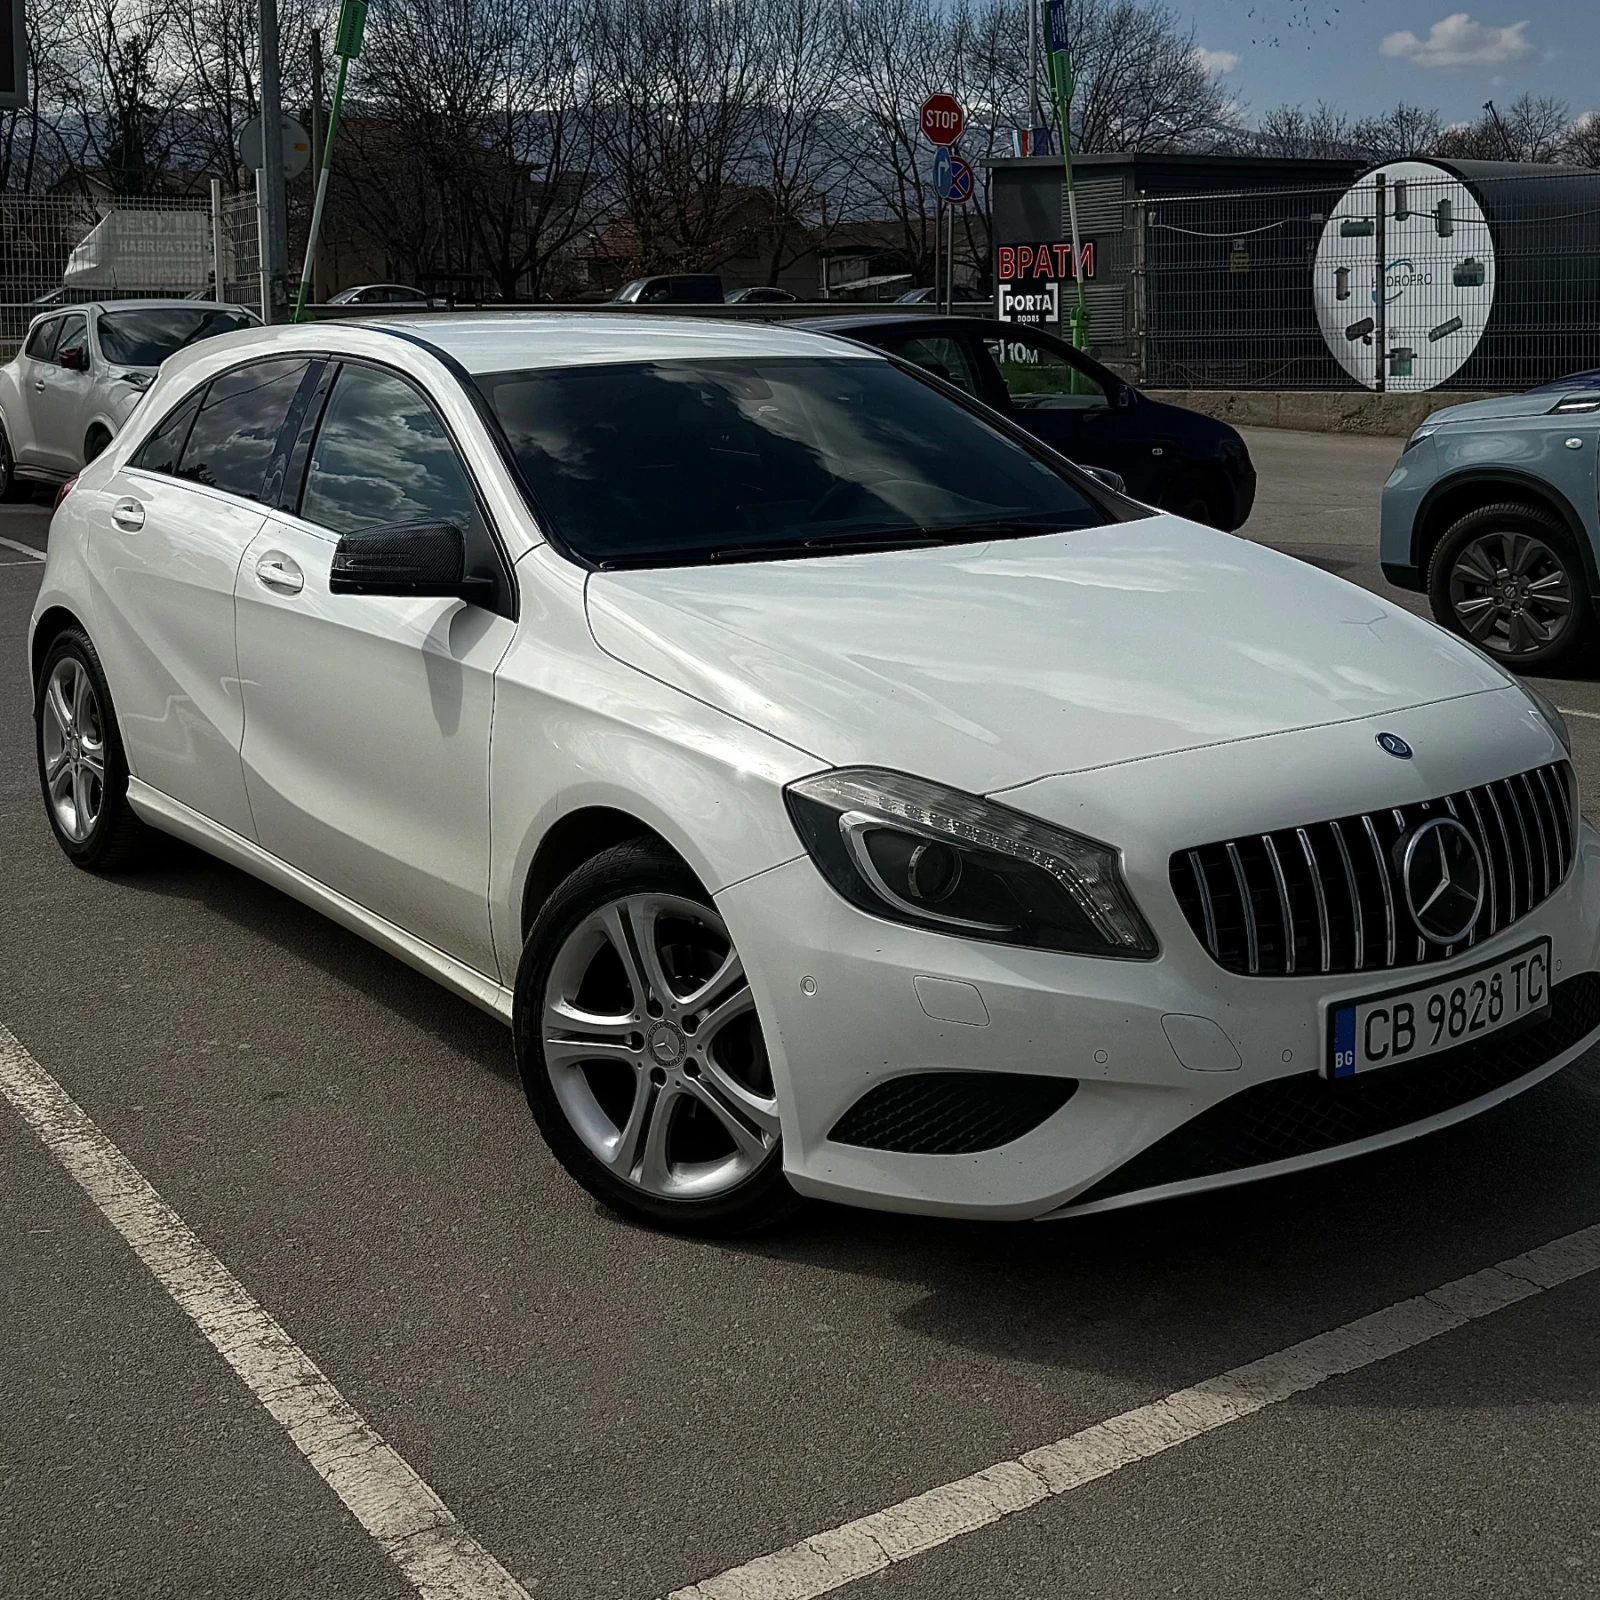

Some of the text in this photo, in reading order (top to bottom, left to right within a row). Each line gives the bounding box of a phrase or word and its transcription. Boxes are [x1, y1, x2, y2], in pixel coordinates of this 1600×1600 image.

[925, 109, 959, 129] STOP
[999, 243, 1094, 279] ВРАТИ
[1372, 273, 1433, 288] HDROPRO
[1005, 294, 1053, 311] PORTA
[1364, 953, 1544, 1062] CB 9828 TC
[1335, 1051, 1353, 1068] BG
